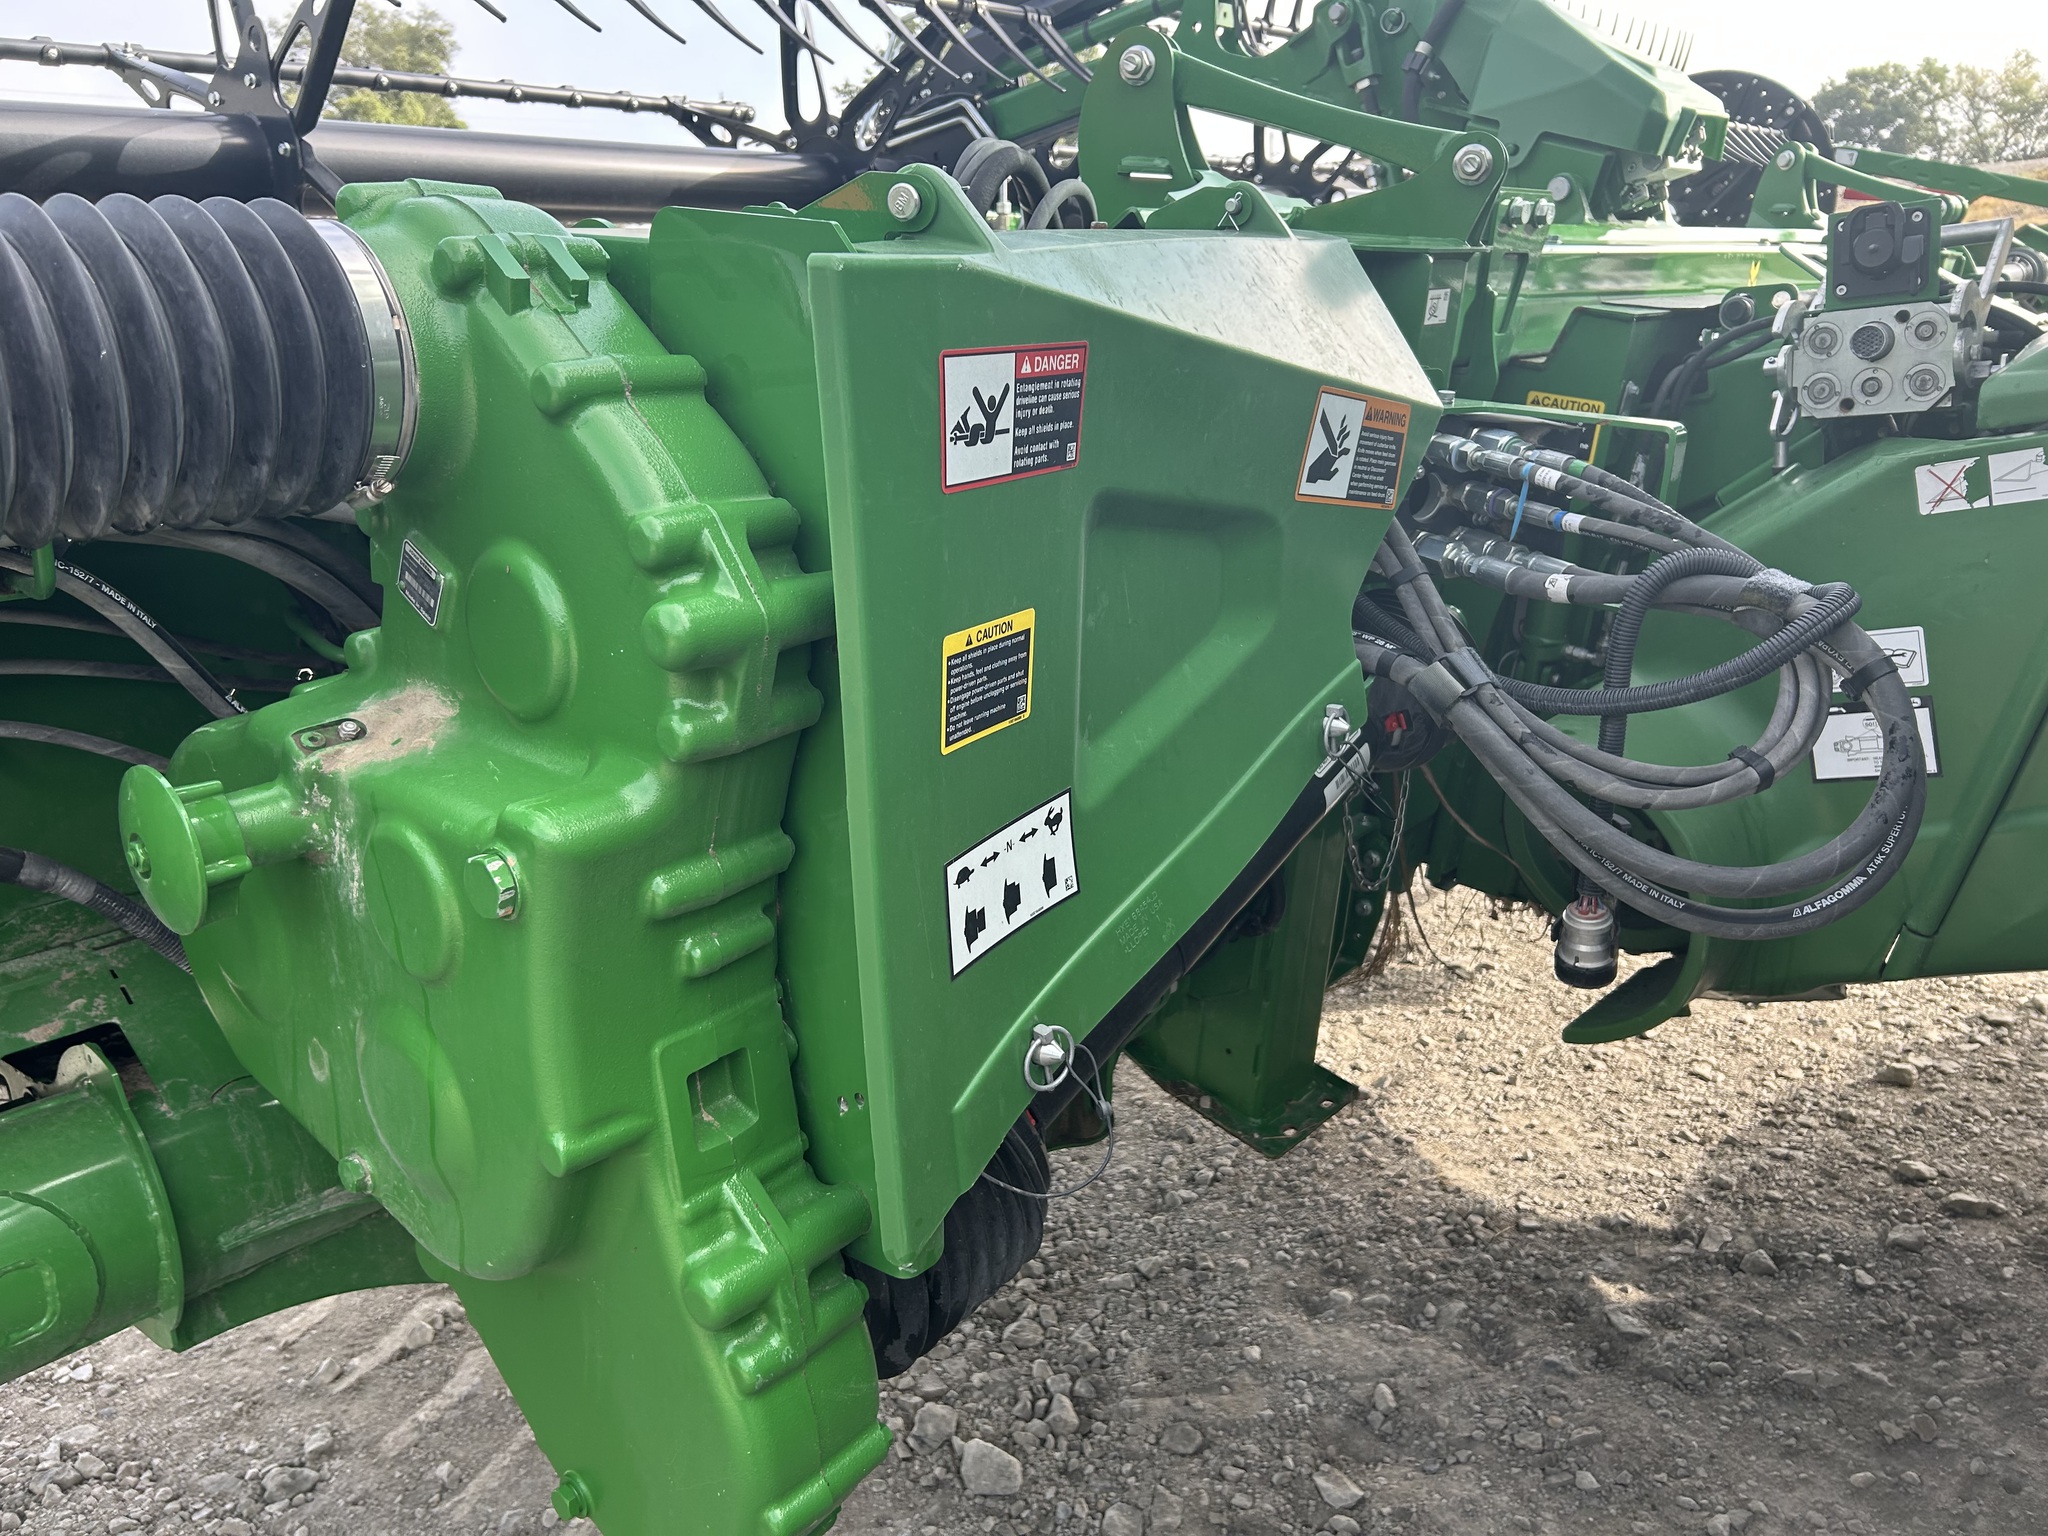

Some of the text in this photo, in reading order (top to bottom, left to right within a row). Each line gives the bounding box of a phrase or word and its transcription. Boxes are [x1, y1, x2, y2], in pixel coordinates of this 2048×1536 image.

[1034, 354, 1080, 372] DANGER
[1016, 378, 1081, 393] Entanglement in rotating
[1016, 390, 1080, 405] driveline can cause serious
[1542, 396, 1600, 414] CAUTION
[1016, 408, 1031, 419] injury
[1039, 404, 1054, 415] death.
[1373, 408, 1406, 427] WARNING
[1015, 427, 1027, 437] Keep
[1036, 423, 1053, 434] shields
[1054, 421, 1059, 431] in
[1060, 420, 1074, 432] place.
[1014, 439, 1059, 456] Avoid contact with
[1014, 454, 1049, 468] rotating parts.
[54, 558, 95, 584] IC-152/7
[101, 584, 126, 606] MADE
[127, 602, 136, 614] IN
[136, 609, 157, 630] ITALY
[976, 620, 1013, 642] CAUTION
[951, 657, 961, 666] Keep
[968, 649, 982, 660] shields
[987, 644, 998, 653] place
[998, 639, 1012, 648] during
[1012, 634, 1025, 644] normal
[950, 676, 961, 684] Keep
[992, 658, 1007, 668] clothing
[950, 691, 971, 704] Disengage
[997, 676, 1007, 686] parts
[970, 695, 982, 705] before
[983, 686, 1004, 699] unclogging
[1010, 678, 1027, 688] servicing
[231, 699, 248, 714] ALF
[974, 711, 990, 721] running
[1590, 849, 1686, 909] IC-152/7 MADE IN ITALY
[1803, 875, 1867, 915] ALFAGOMMA
[1866, 853, 1886, 874] AT4K
